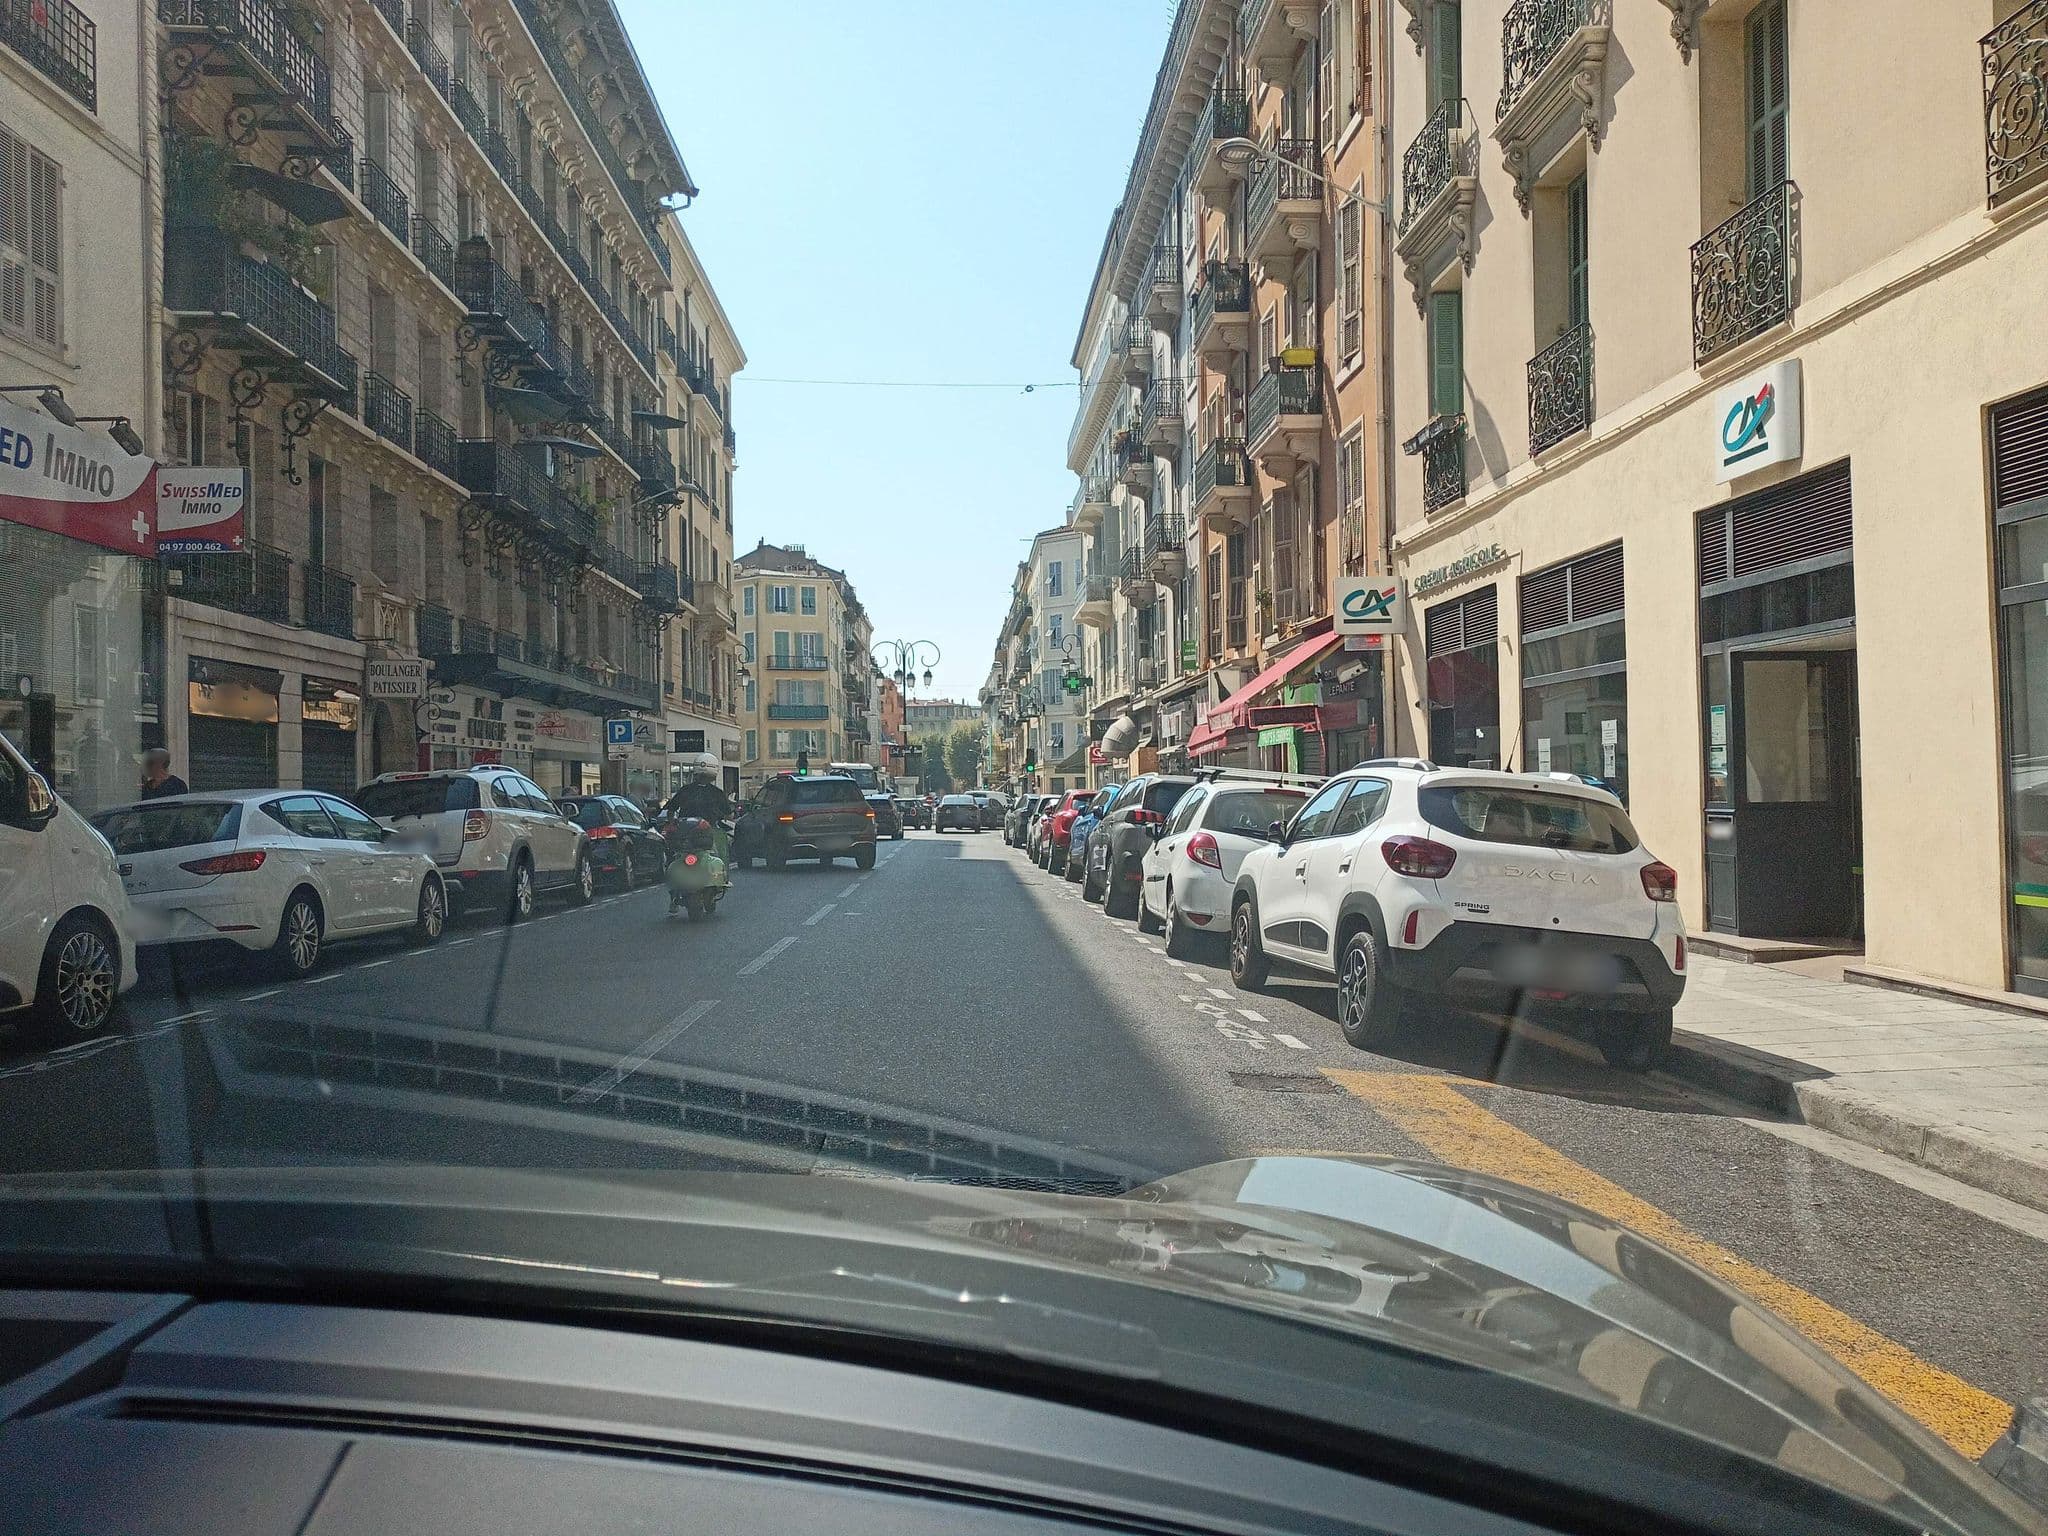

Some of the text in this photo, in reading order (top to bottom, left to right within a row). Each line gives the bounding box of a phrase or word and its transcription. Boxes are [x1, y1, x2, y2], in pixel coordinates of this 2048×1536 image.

[43, 432, 114, 498] IMMO
[181, 499, 222, 514] IMMO
[159, 543, 221, 551] 04 97 000 462
[1448, 543, 1501, 578] AGRICOLE
[370, 664, 421, 677] BOULANGER
[373, 681, 417, 694] PATISSIER
[614, 724, 626, 740] P
[1504, 863, 1600, 886] DACIA
[1454, 901, 1490, 910] SPRING
